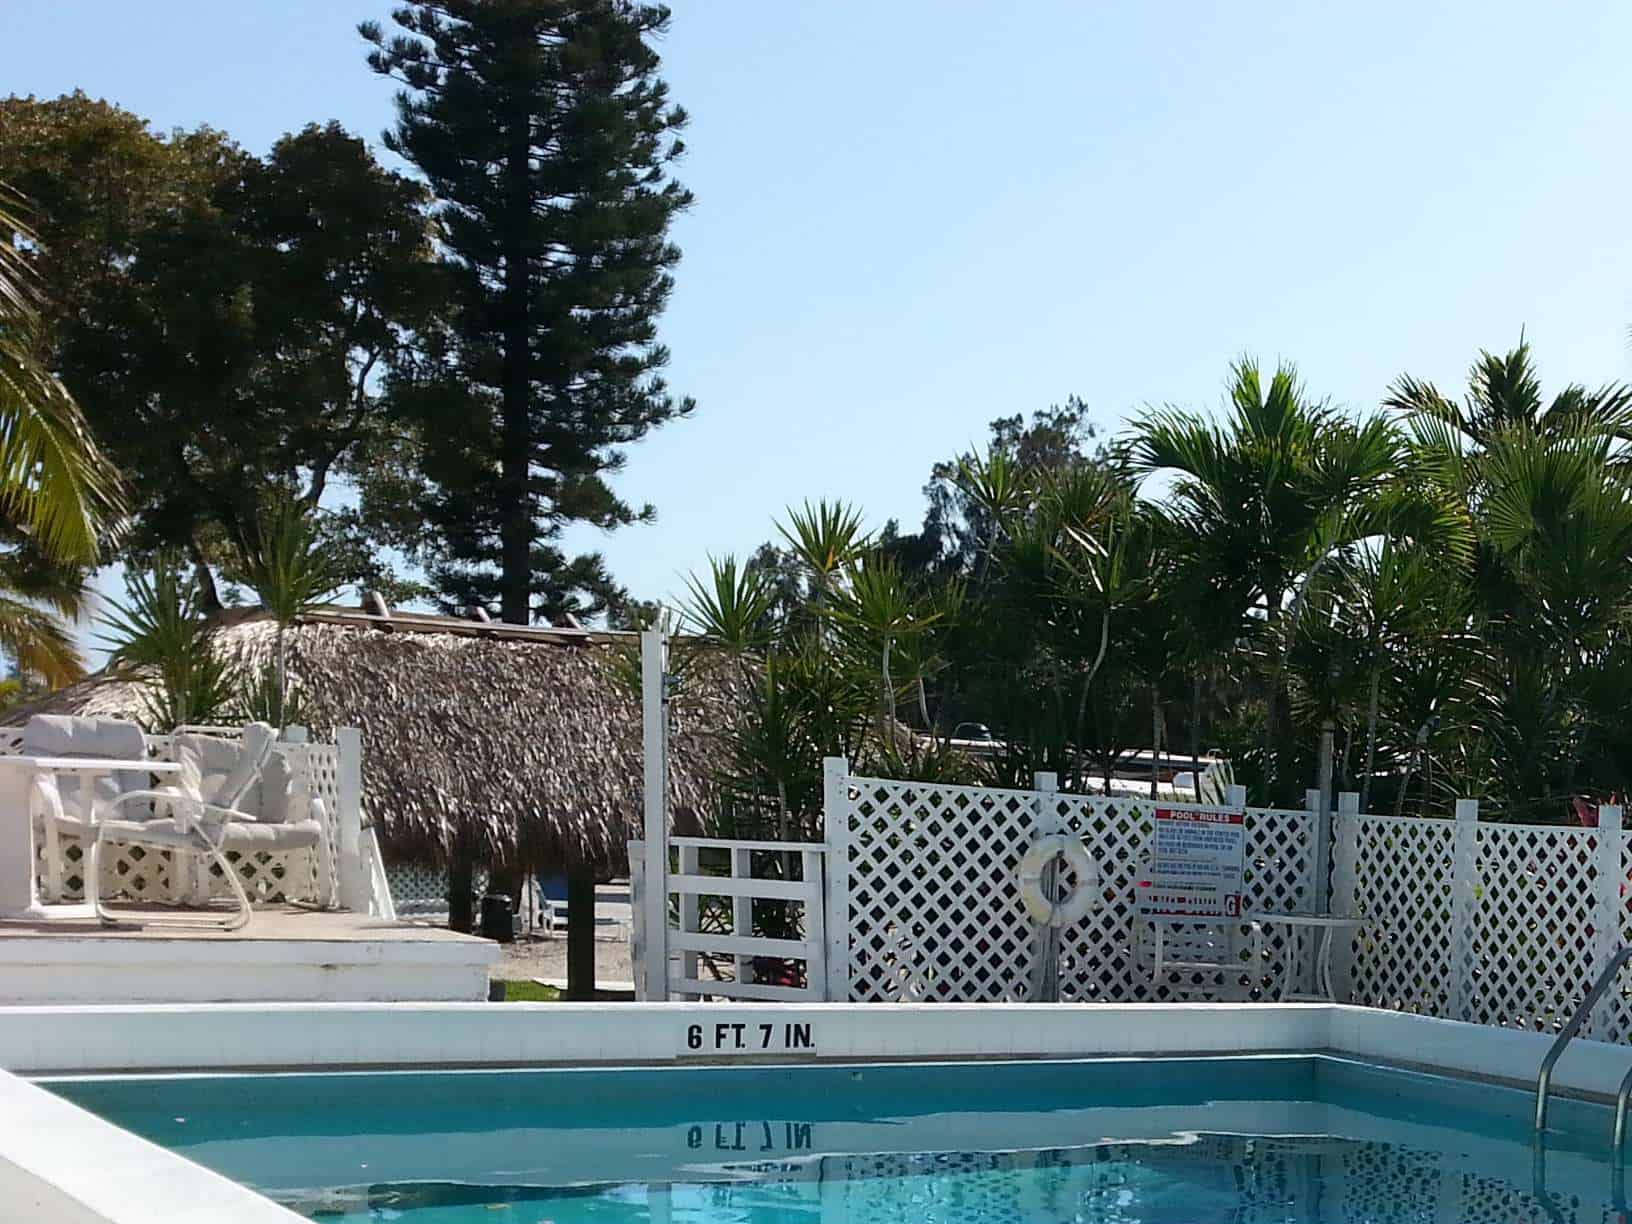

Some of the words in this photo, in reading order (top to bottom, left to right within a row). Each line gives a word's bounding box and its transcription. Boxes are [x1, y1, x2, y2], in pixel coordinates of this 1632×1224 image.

[1170, 810, 1195, 821] POOL
[1199, 812, 1230, 823] RULES
[687, 1024, 703, 1049] 6
[715, 1024, 746, 1049] FT.
[759, 1024, 773, 1049] 7
[785, 1024, 816, 1049] IN.
